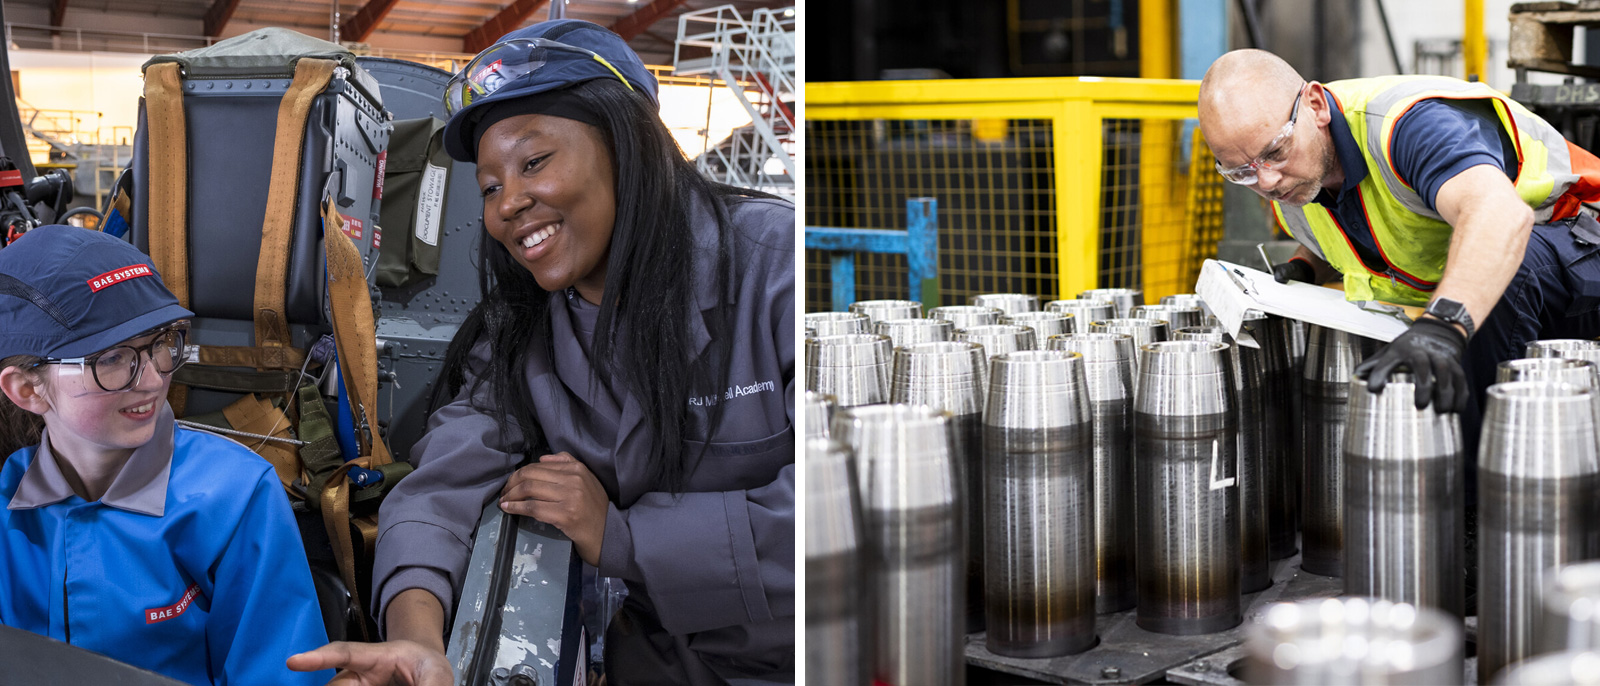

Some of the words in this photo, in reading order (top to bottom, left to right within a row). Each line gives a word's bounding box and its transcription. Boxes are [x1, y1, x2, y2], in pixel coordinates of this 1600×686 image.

[376, 160, 385, 188] WARNING
[428, 170, 436, 201] STOWAGE
[93, 276, 114, 288] BAE
[114, 267, 149, 280] SYSTEMS
[689, 397, 703, 406] RJ
[735, 381, 774, 397] Academy
[150, 609, 173, 620] BAE
[176, 585, 201, 613] SYSTEMS
